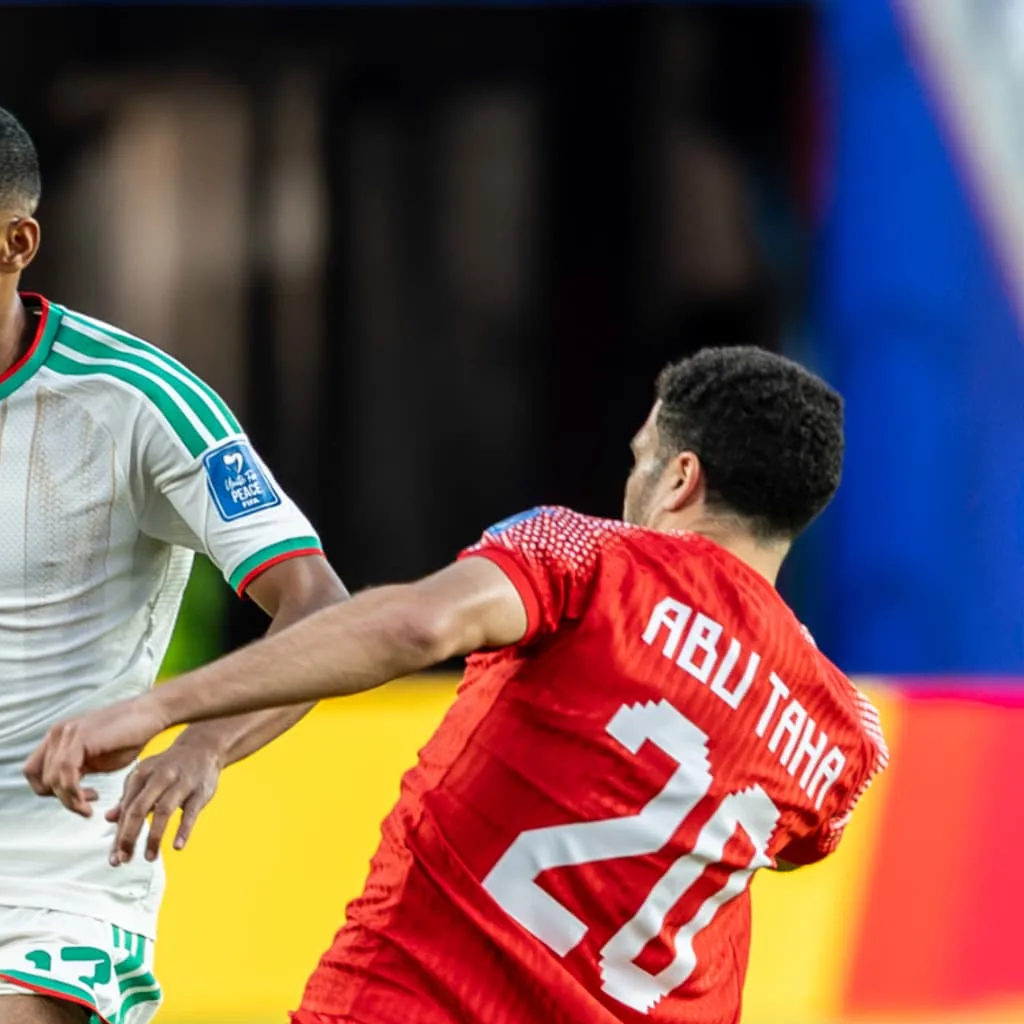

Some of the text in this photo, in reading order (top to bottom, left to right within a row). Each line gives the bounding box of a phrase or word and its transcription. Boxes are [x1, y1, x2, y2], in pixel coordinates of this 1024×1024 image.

[641, 596, 847, 810] ABU TAHA
[481, 698, 781, 1015] 20
